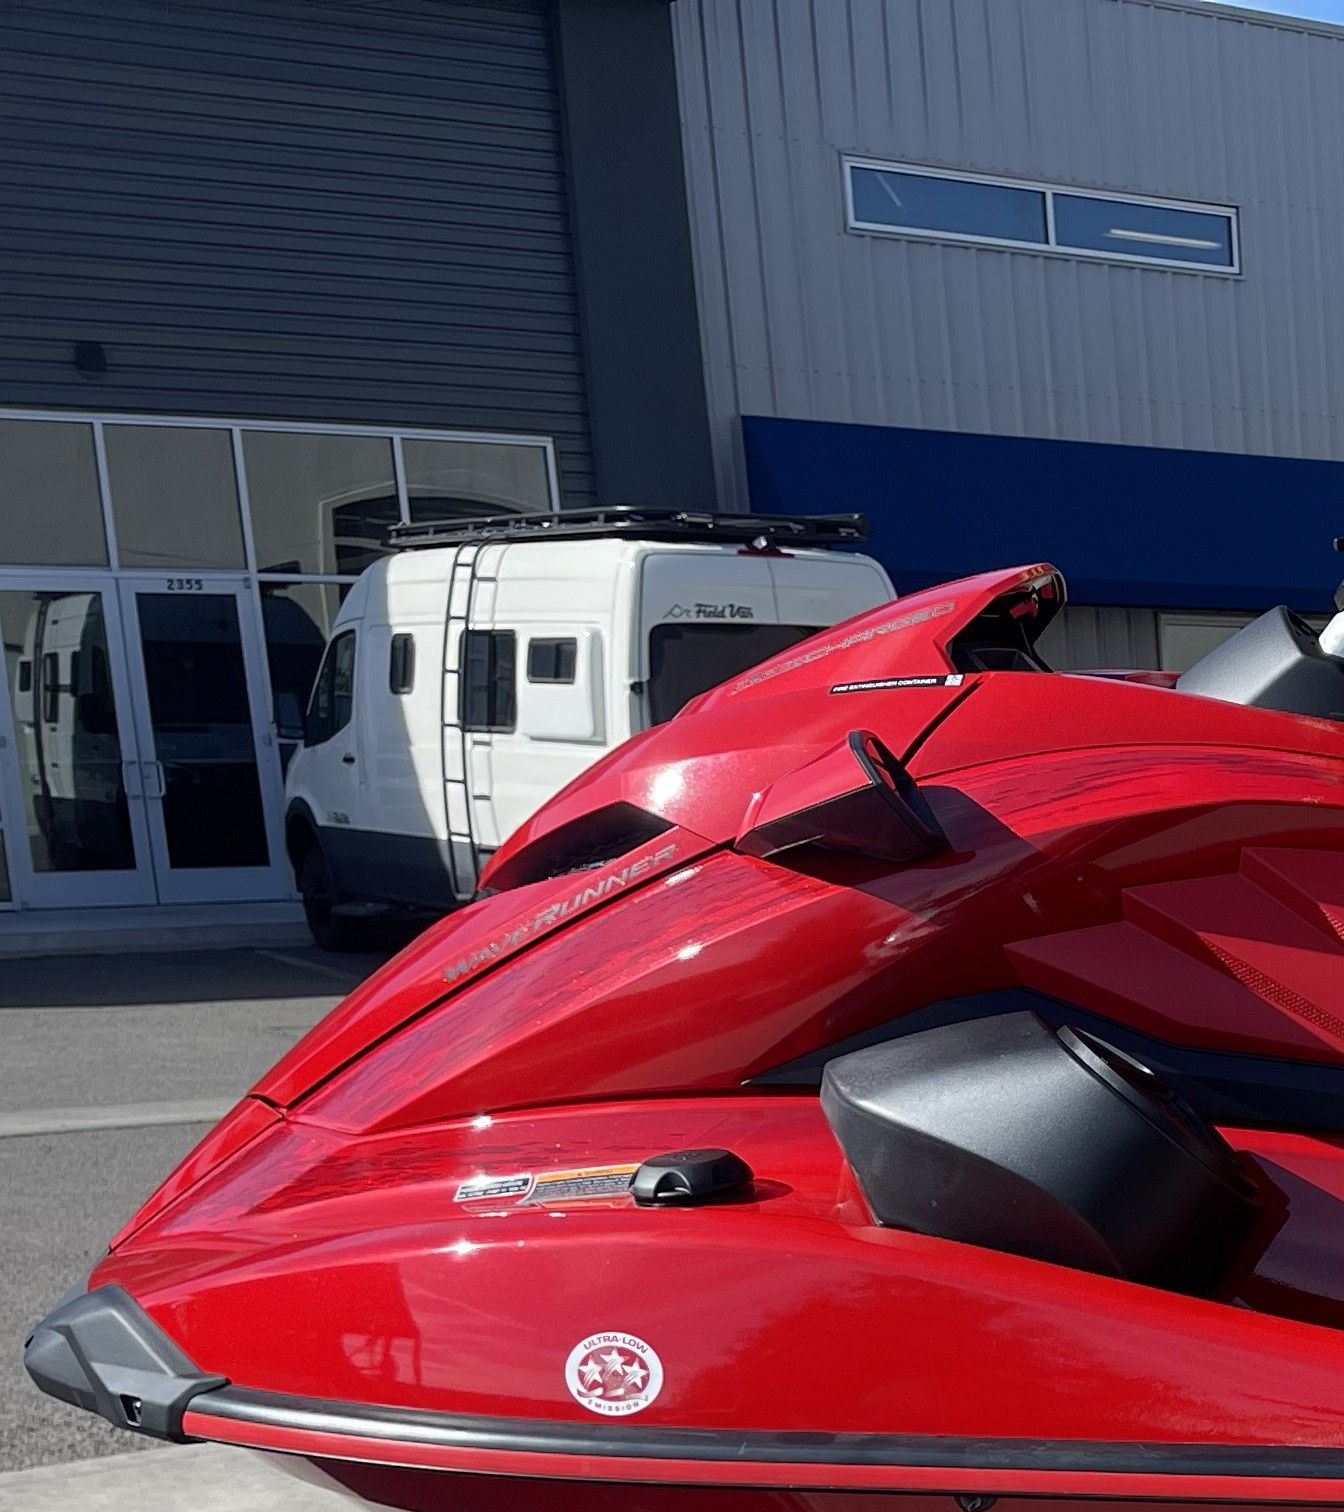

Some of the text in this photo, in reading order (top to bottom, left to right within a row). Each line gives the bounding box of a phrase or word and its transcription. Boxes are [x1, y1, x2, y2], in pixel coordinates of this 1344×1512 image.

[167, 579, 203, 591] 2355
[728, 603, 754, 618] Van
[849, 681, 897, 690] EXTINGUISHER
[898, 678, 937, 686] CONTAINER
